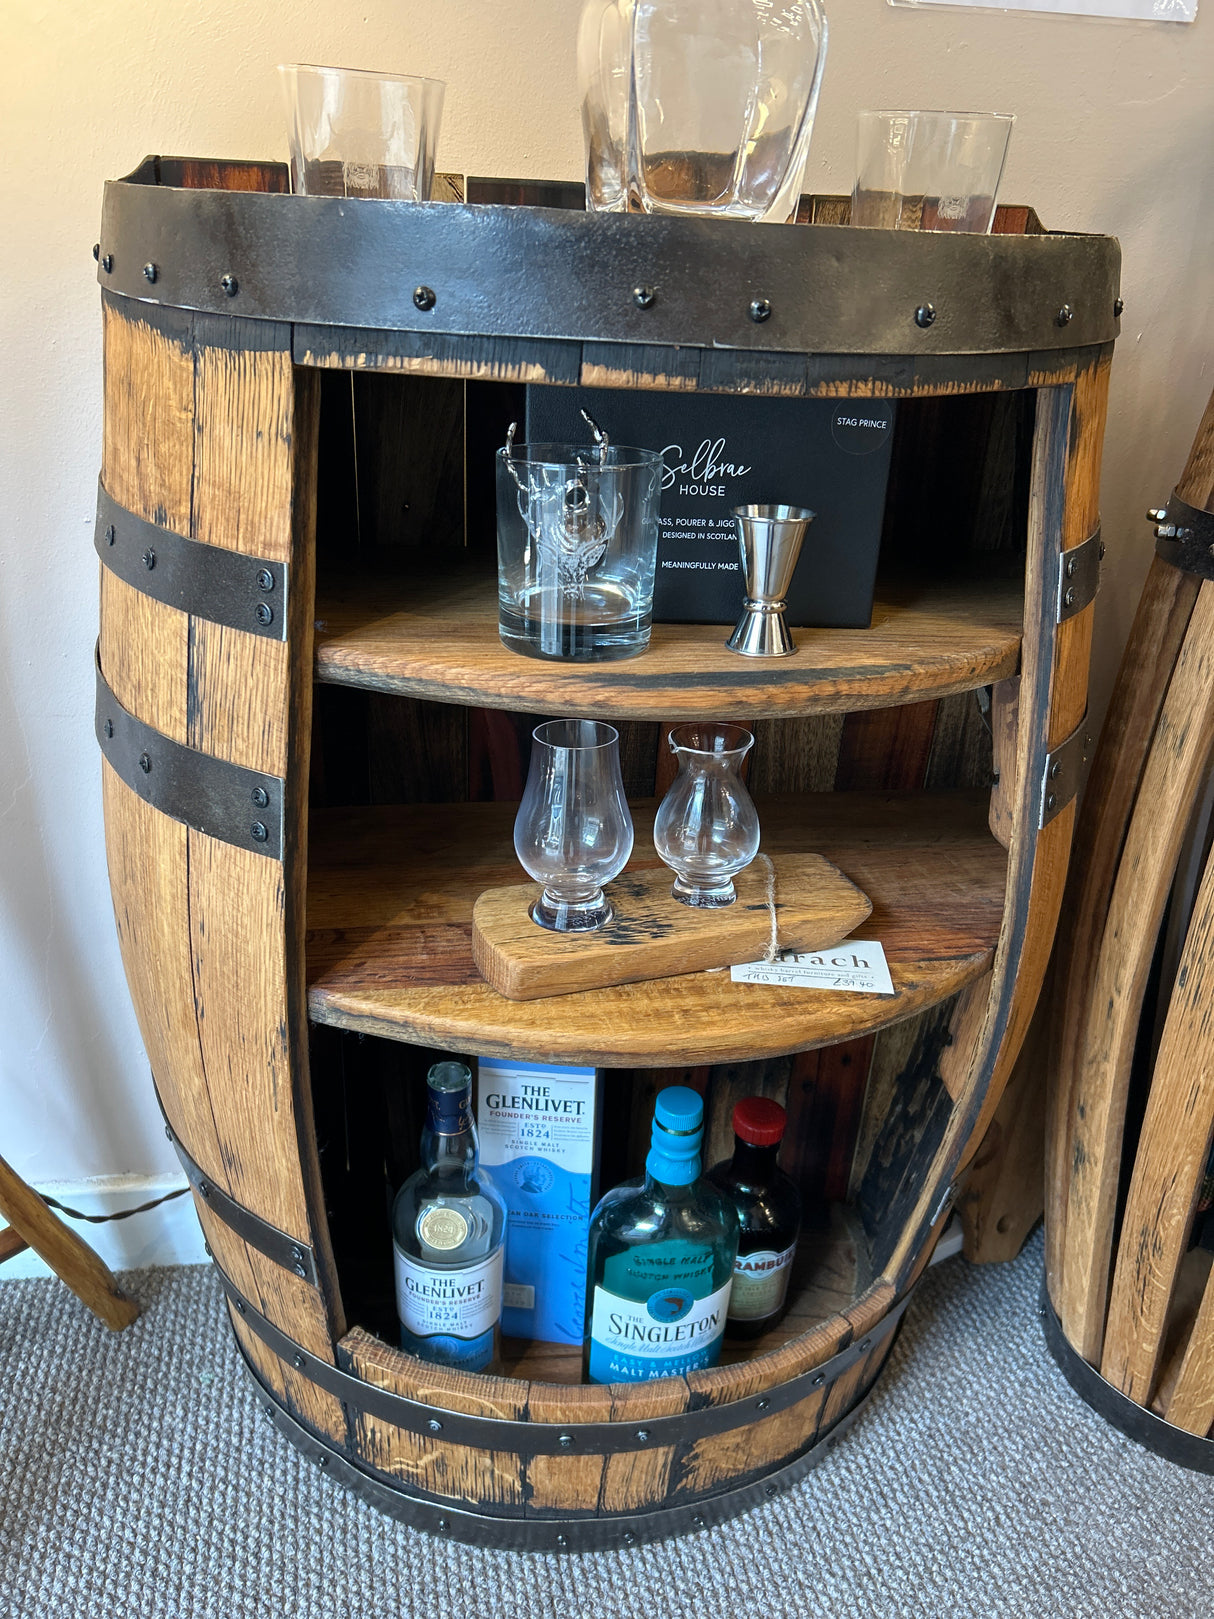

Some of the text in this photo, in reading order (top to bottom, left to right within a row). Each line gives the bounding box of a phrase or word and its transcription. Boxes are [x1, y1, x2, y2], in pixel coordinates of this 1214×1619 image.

[837, 416, 887, 429] STAG PRINCE
[660, 437, 752, 490] Selbrae
[679, 484, 726, 496] HOUSE
[675, 518, 706, 527] POURER
[708, 519, 714, 527] &
[716, 520, 735, 528] JIGG
[662, 531, 696, 540] DESIGNED
[661, 561, 739, 571] MEANINGFULLY MADE
[521, 1085, 550, 1097] THE
[489, 1110, 582, 1124] FOUNDER'S RESERVE
[520, 1128, 550, 1139] 1824
[504, 1144, 536, 1152] SCOTCH
[511, 1139, 537, 1147] SINGLE
[541, 1213, 583, 1221] SELECTION
[633, 1251, 713, 1266] SINGLE MALT
[674, 1264, 714, 1280] WHISKY
[431, 1278, 456, 1287] THE
[408, 1291, 447, 1305] FOUNDER'S
[448, 1294, 481, 1305] RESERVE
[430, 1311, 458, 1320] 1824
[628, 1315, 643, 1323] THE
[417, 1321, 473, 1331] SCOTCH WHISKY
[422, 1319, 446, 1327] SINGLE
[608, 1310, 720, 1342] SINGLETON
[613, 1354, 643, 1367] EASY
[663, 1350, 707, 1367] MELLOW
[609, 1362, 644, 1377] MALT
